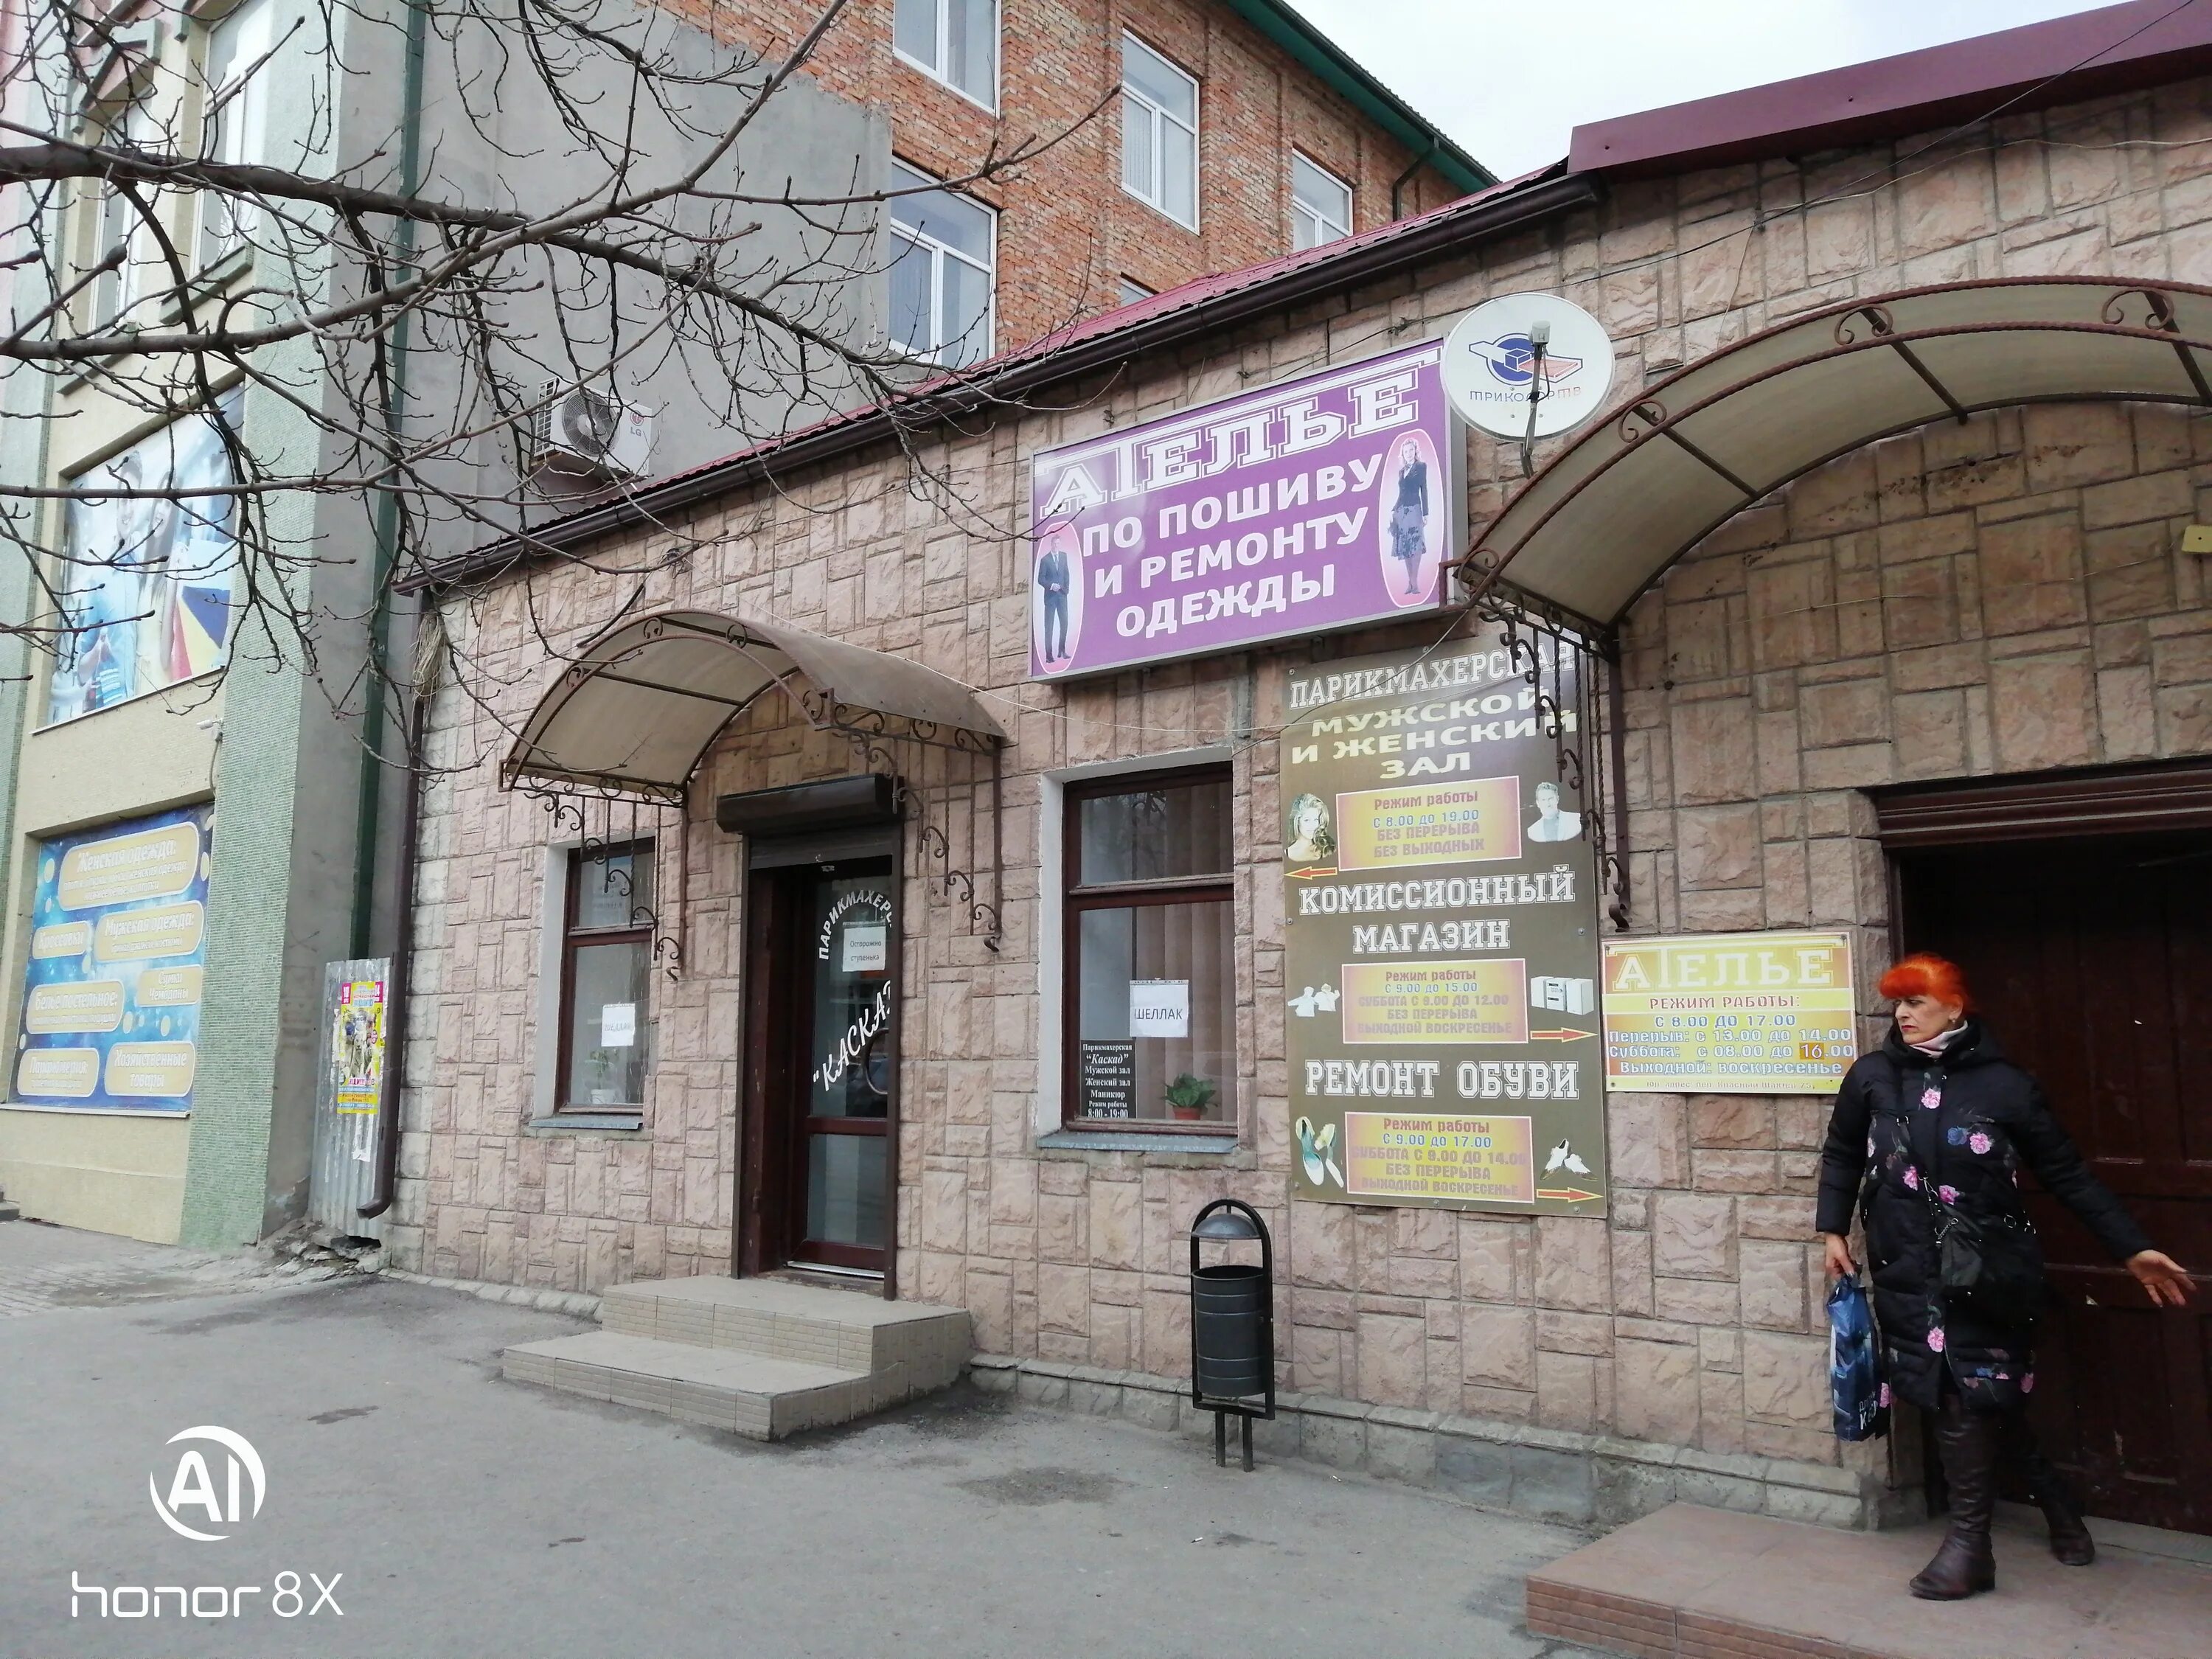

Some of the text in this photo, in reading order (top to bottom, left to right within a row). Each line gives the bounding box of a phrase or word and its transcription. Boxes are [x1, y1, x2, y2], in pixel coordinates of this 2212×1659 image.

[630, 426, 641, 437] LG
[1034, 346, 1442, 519] АТЕЛЬЕ
[1082, 453, 1383, 557] ПО ПОШИВУ
[1094, 506, 1368, 599] И РЕМОНТУ
[1116, 564, 1336, 639] ОДЕЖДЫ
[1289, 640, 1576, 710] ПАРИКМАХЕРСКАЯ
[1311, 685, 1550, 737] МУЖСКОЙ
[1292, 709, 1577, 764] И ЖЕНСКИЙ
[1380, 751, 1471, 779] ЗАЛ
[1374, 790, 1478, 810] Режим работы
[1386, 815, 1413, 827] 8.00
[1442, 809, 1480, 822] 19.00
[1377, 821, 1481, 841] БЕЗ ПЕРЕРЫВА
[1374, 838, 1485, 858] БЕЗ ВЫХОДНЫХ
[1298, 863, 1576, 916] КОМИССИОННЫЙ
[818, 888, 892, 960] ПАРИКМАХЕРС
[1352, 918, 1511, 954] МАГАЗИН
[849, 940, 882, 949] Осторожно
[850, 954, 880, 962] ступенька
[1606, 936, 1847, 991] АТЕЛЬЕ
[1385, 970, 1476, 981] Режим работы
[1397, 984, 1421, 993] 9.00
[1445, 982, 1478, 992] 15.00
[1358, 995, 1408, 1007] СУББОТА
[1422, 995, 1449, 1006] 9.00
[1452, 995, 1470, 1007] ДО
[1474, 994, 1509, 1006] 12.00
[1650, 995, 1800, 1009] РЕЖИМ РАБОТЫ:
[1134, 1008, 1183, 1020] ШЕЛЛАК
[1387, 1008, 1478, 1020] БЕЗ ПЕРЕРЫВА
[1672, 1016, 1708, 1027] 8.00
[1746, 1015, 1795, 1026] 17.00
[1357, 1021, 1512, 1035] ВЫХОДНОЙ ВОСКРЕСЕНЬЕ
[1609, 1030, 1689, 1043] Перерыв:
[1713, 1029, 1761, 1042] 13.00
[1799, 1029, 1851, 1041] 14.00
[1082, 1043, 1133, 1052] Парикмахерская
[1609, 1046, 1680, 1058] Суббота:
[1714, 1046, 1764, 1057] 08.00
[1800, 1044, 1854, 1059] 16.00
[1085, 1065, 1118, 1076] Мужской
[1620, 1060, 1843, 1076] Выходной: воскресенье
[1085, 1077, 1118, 1086] Женский
[1304, 1060, 1579, 1100] РЕМОНТ ОБУВИ
[1091, 1089, 1126, 1100] Маникюр
[1107, 1101, 1127, 1109] работы
[1088, 1108, 1103, 1119] 8:00
[1109, 1108, 1129, 1119] 19:00
[1383, 1118, 1489, 1133] Режим работы
[1396, 1134, 1425, 1146] 9.00
[1453, 1136, 1492, 1148] 17.00
[1350, 1147, 1409, 1161] СУББОТА
[1427, 1150, 1458, 1163] 9.00
[1462, 1150, 1482, 1164] ДО
[1385, 1163, 1492, 1180] БЕЗ ПЕРЕРЫВА
[1361, 1176, 1519, 1197] ВЫХОДНОЙ ВОСКРЕСЕНЬЕ
